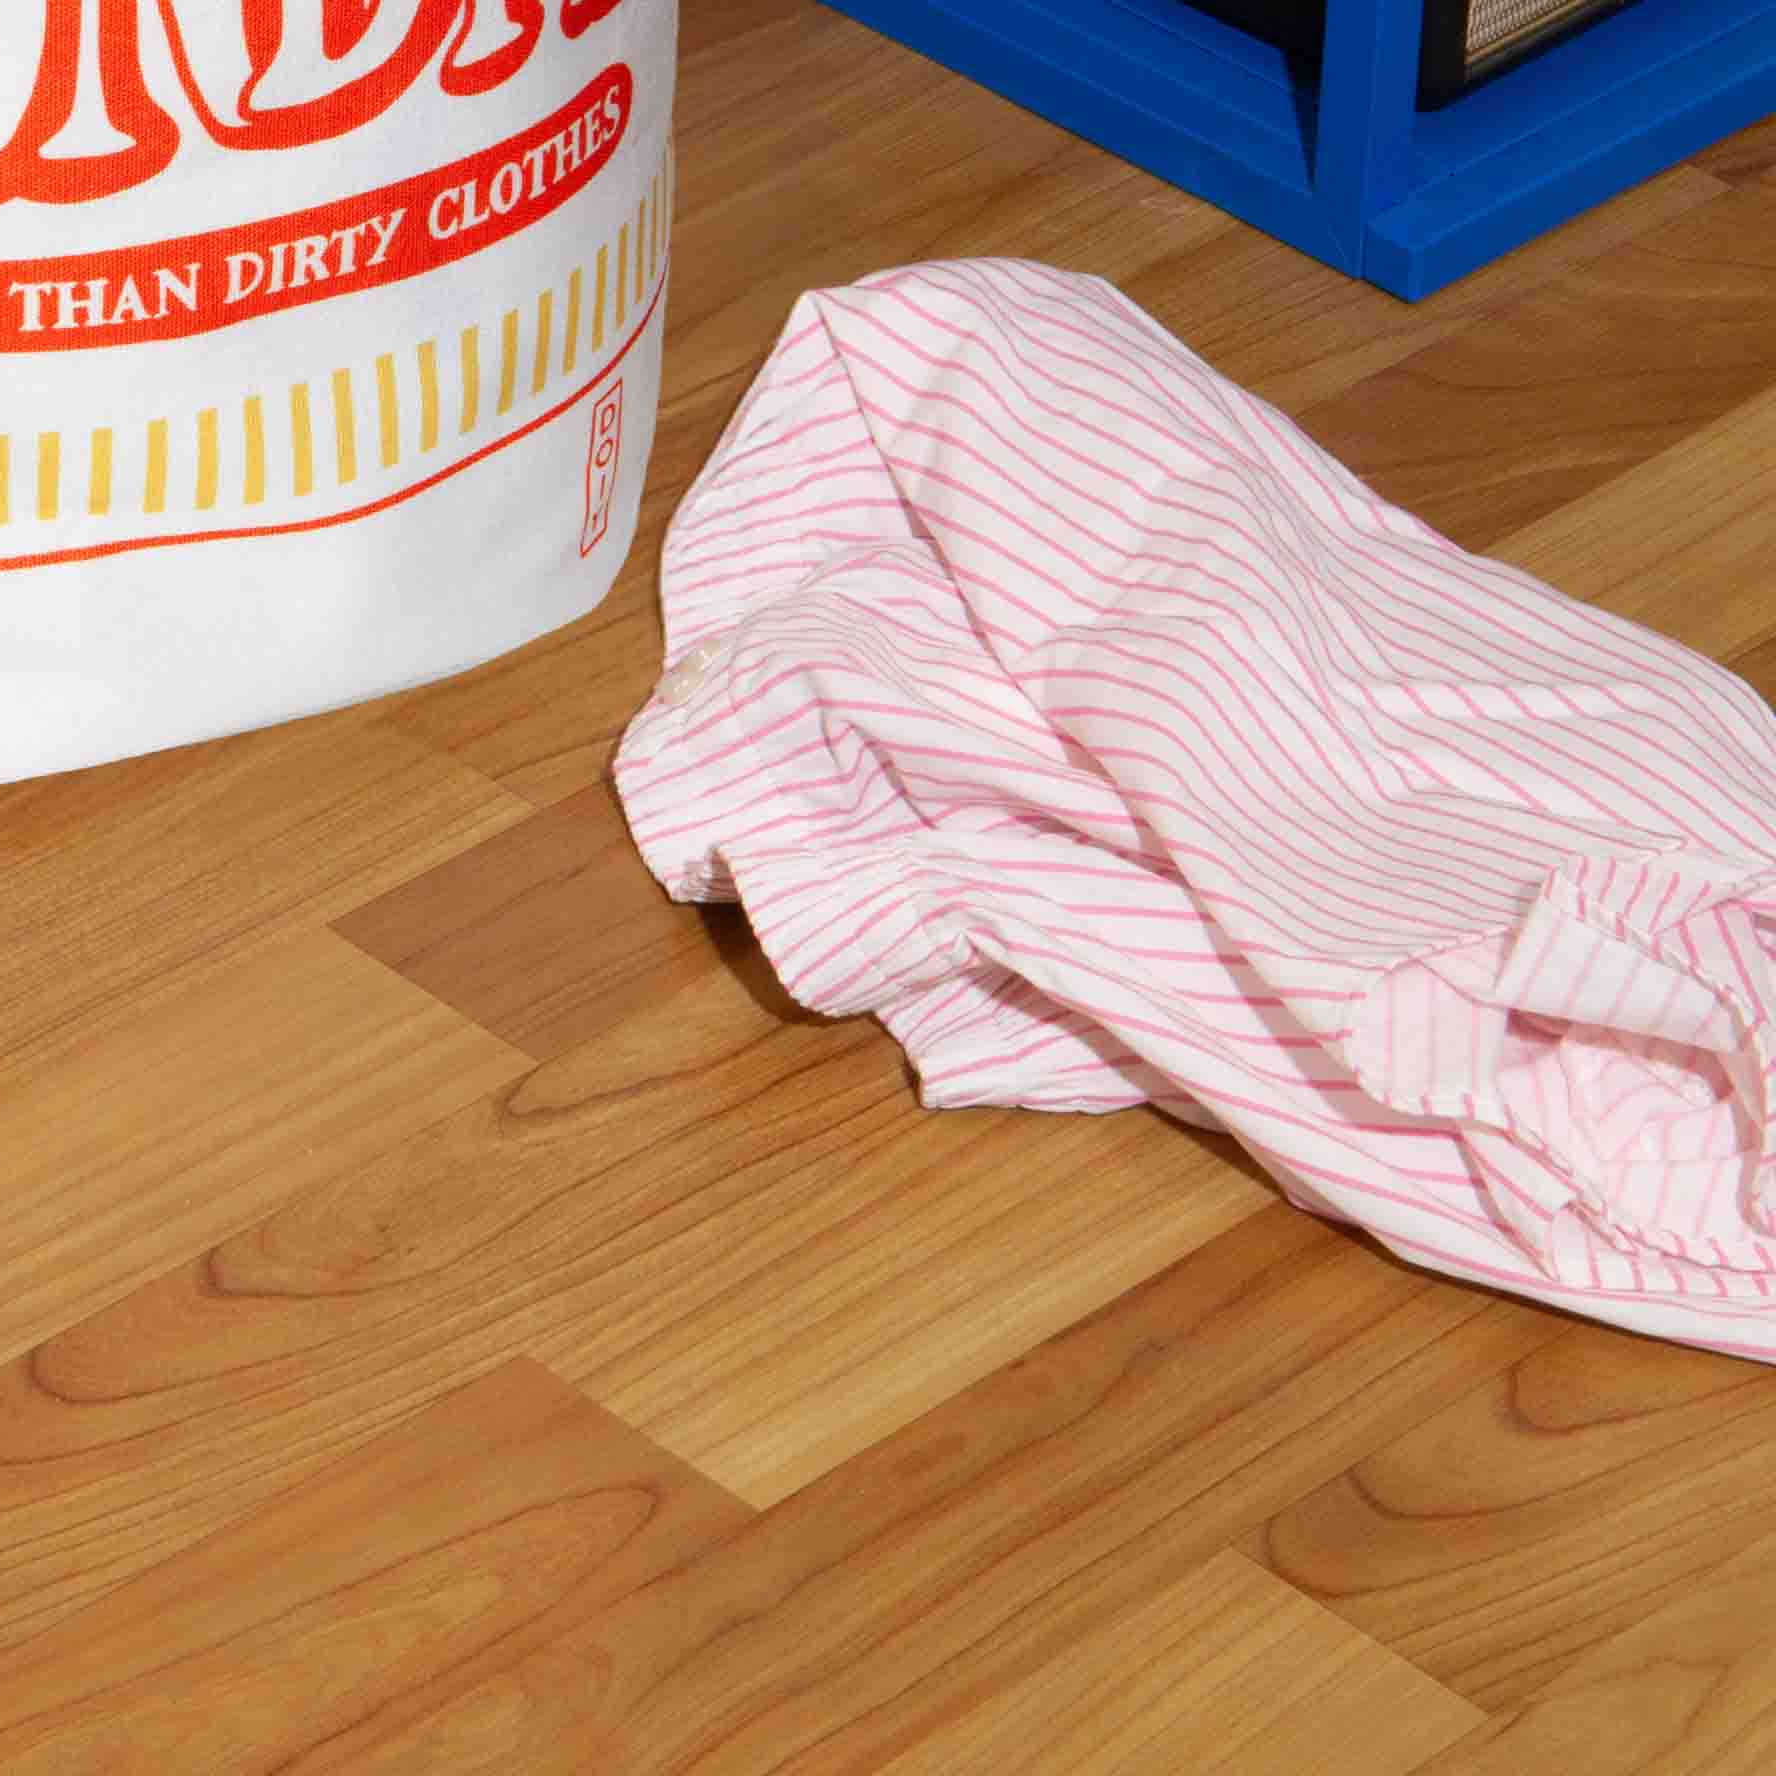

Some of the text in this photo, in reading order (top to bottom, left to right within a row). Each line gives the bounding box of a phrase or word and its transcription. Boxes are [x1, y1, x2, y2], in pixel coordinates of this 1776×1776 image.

[9, 262, 202, 332] THAN
[224, 207, 408, 305] DIRTY
[427, 84, 624, 242] CLOTHES
